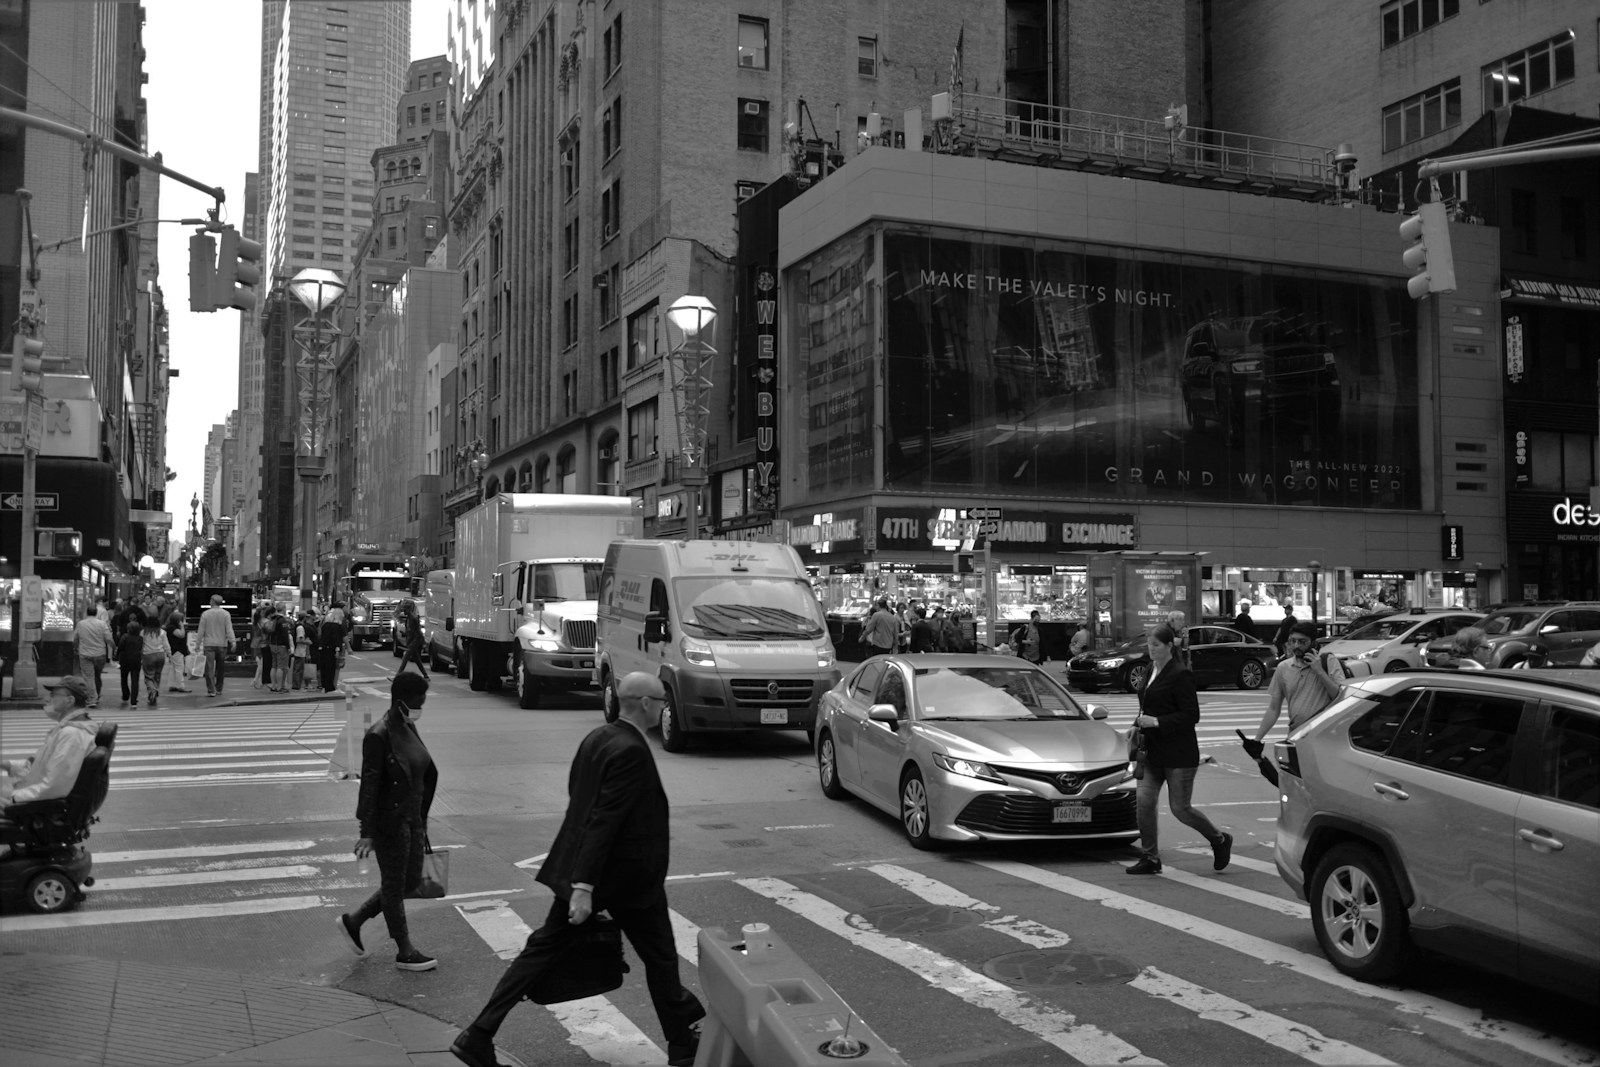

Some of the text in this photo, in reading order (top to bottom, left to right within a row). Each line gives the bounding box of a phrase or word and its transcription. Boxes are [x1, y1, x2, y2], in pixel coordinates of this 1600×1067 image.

[920, 269, 1176, 308] MAKE THE VALET'S NIGHT.
[757, 300, 776, 360] WE
[757, 391, 774, 487] BUY
[1104, 466, 1214, 486] GRAND
[1289, 460, 1400, 474] THE ALL-NEW 2022
[881, 517, 919, 539] 47TH
[1062, 522, 1134, 545] EXCHANGE
[1557, 533, 1578, 541] INDIAN
[713, 553, 760, 562] DHL
